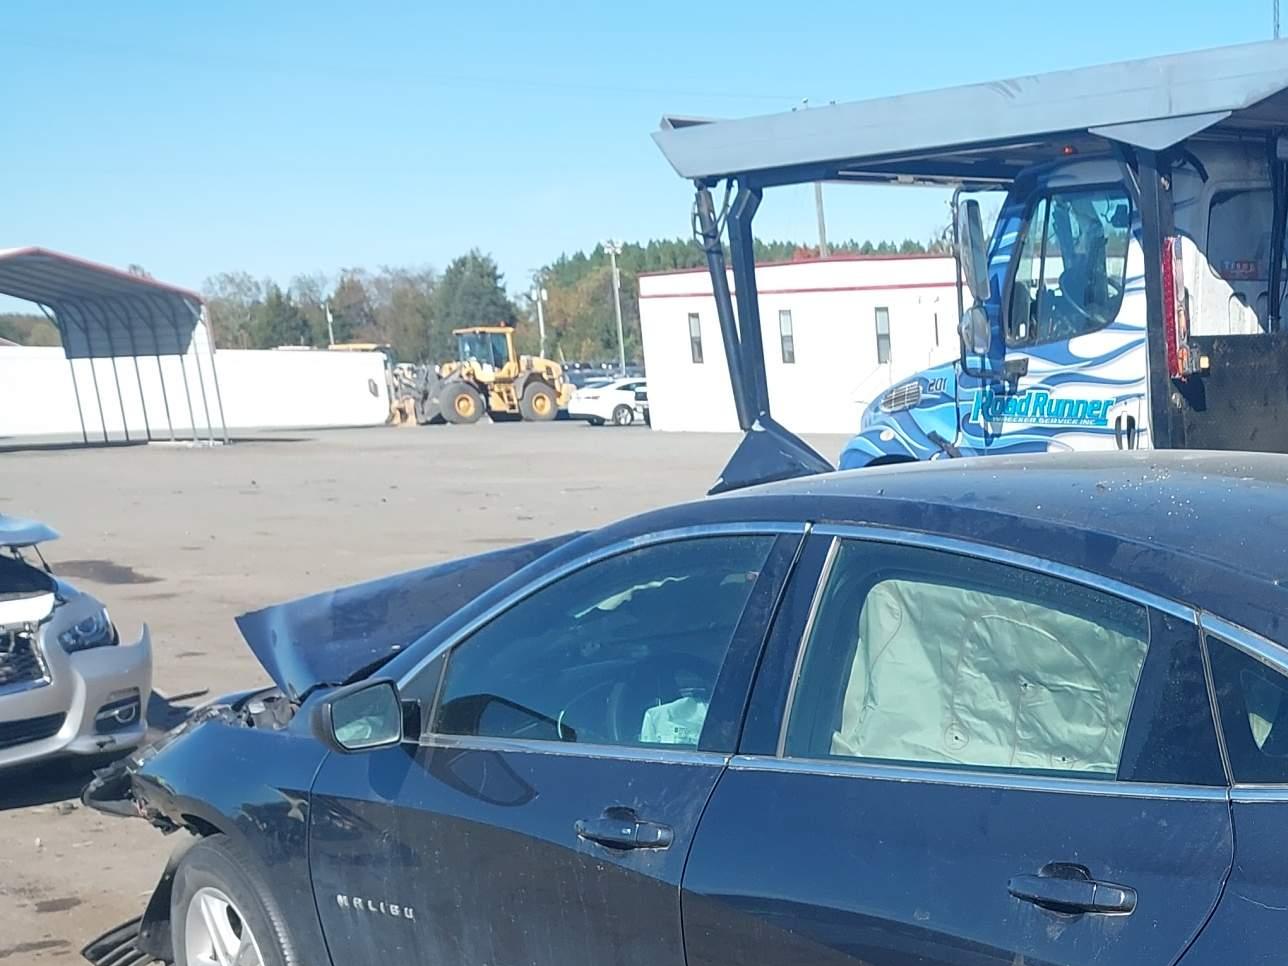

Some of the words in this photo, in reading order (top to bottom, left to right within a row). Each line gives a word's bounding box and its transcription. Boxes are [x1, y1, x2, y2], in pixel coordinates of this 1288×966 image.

[970, 391, 1032, 422] Road
[1030, 391, 1115, 422] Runner
[336, 894, 414, 919] MALIBU
